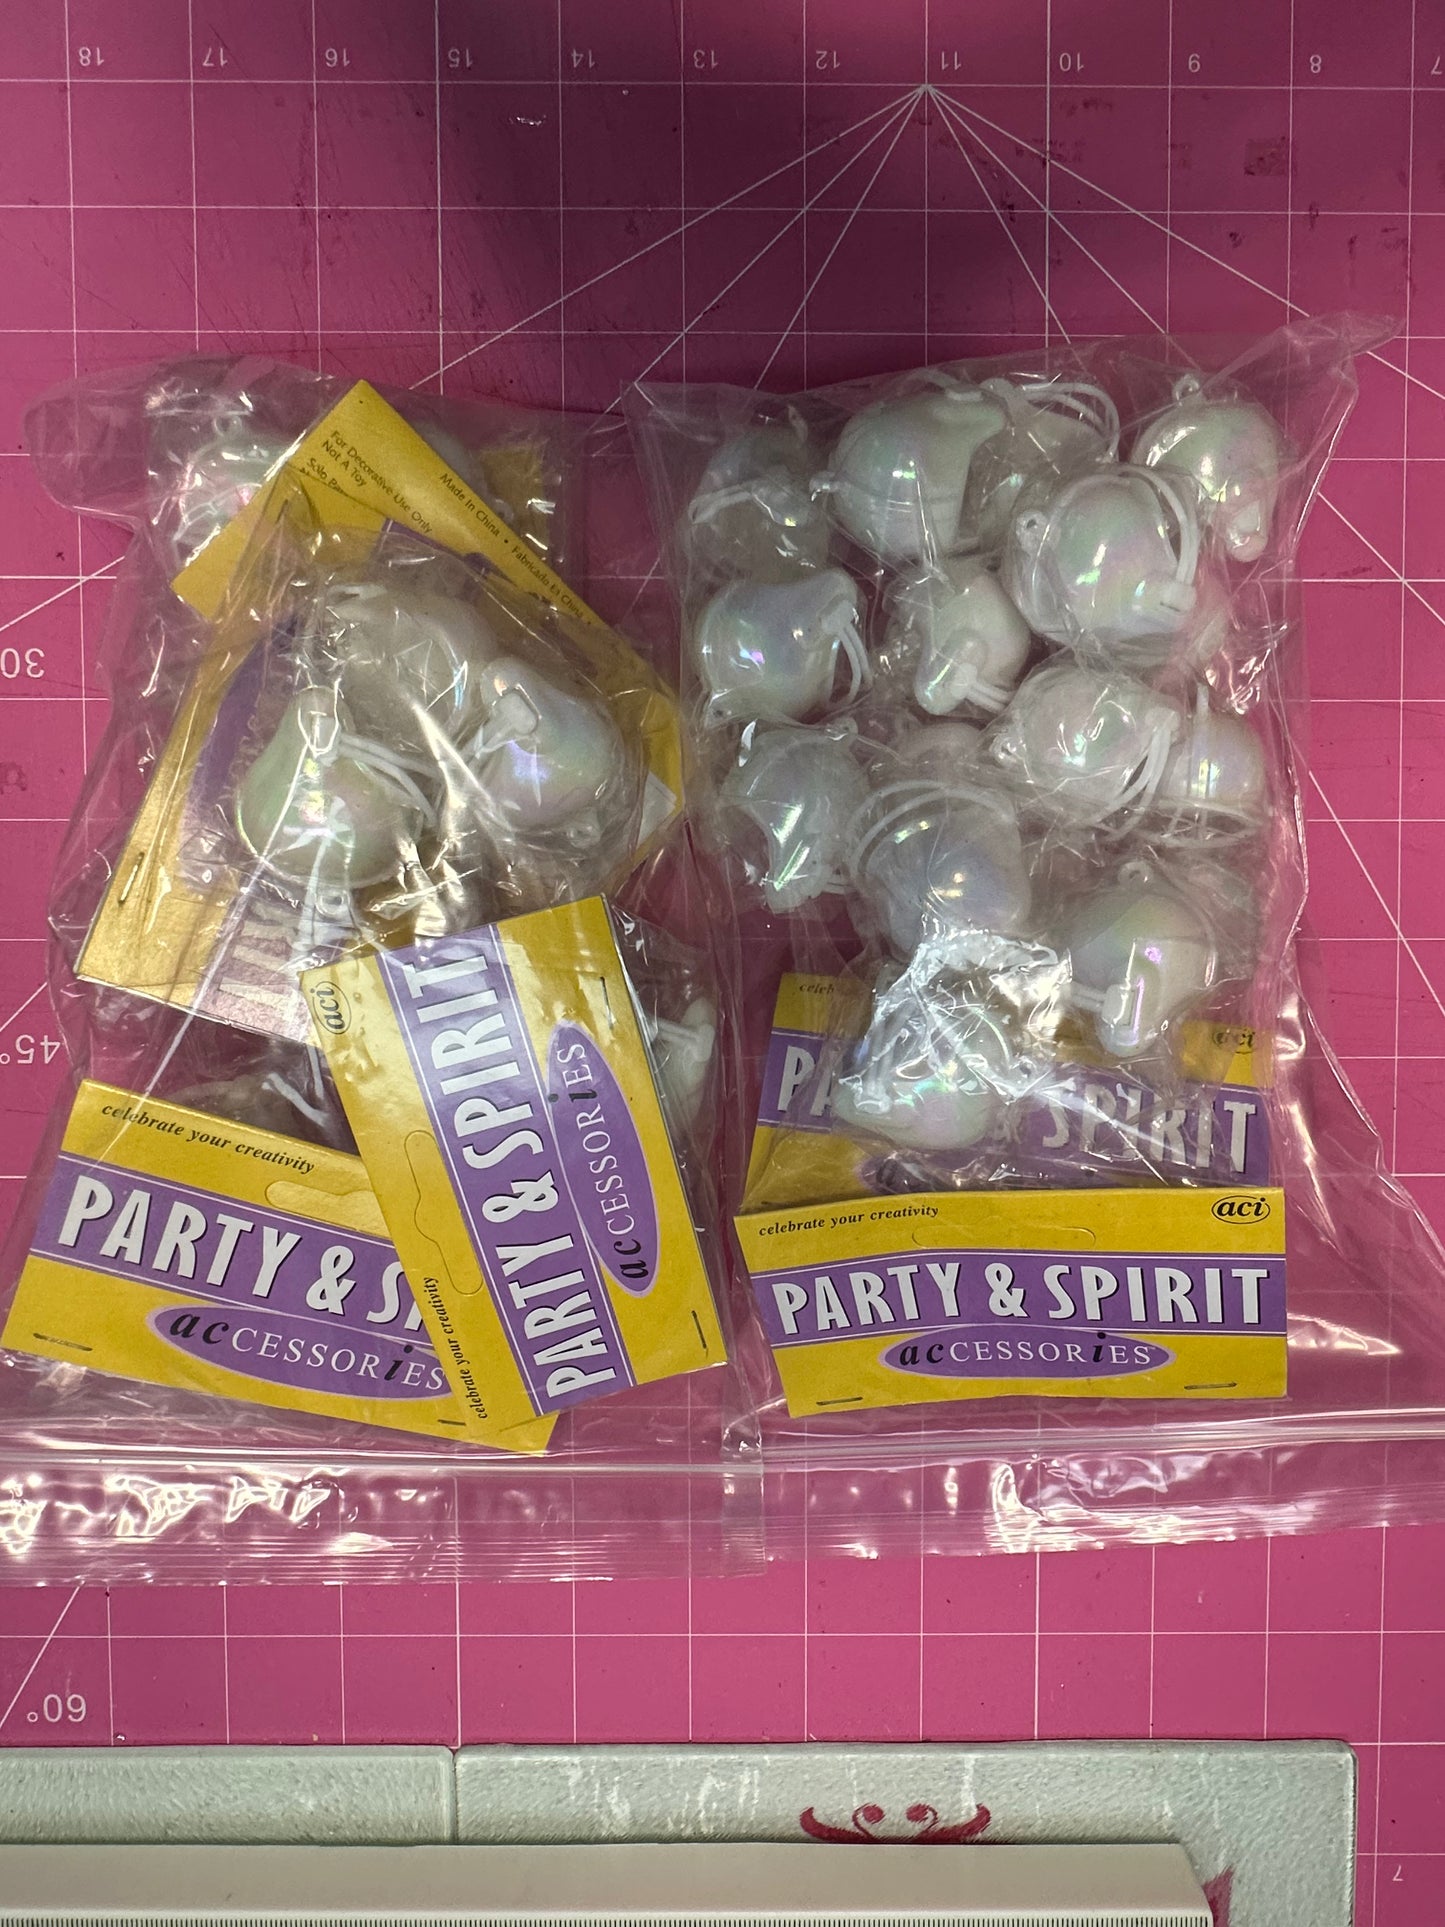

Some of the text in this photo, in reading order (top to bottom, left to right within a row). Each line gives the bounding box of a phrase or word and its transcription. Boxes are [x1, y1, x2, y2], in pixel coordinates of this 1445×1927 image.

[78, 46, 104, 66] 18
[202, 47, 227, 67] 17
[325, 47, 350, 67] 16
[447, 48, 473, 68] 15
[571, 49, 595, 69] 14
[693, 49, 718, 69] 13
[815, 50, 840, 70] 12
[941, 51, 962, 70] 11
[1059, 52, 1084, 72] 10
[1309, 54, 1322, 74] 8
[1430, 55, 1443, 75] 7
[306, 457, 328, 480] Solo
[322, 440, 368, 488] Not A Toy
[331, 430, 432, 535] For Decorative Use Only
[439, 472, 501, 538] Made In China
[511, 545, 550, 587] Fabricado
[101, 1103, 316, 1176] celebrate your creativity
[402, 954, 618, 1399] PARTY & SPIRIT
[1214, 1196, 1268, 1220] aci
[758, 1204, 940, 1237] celebrate your creativity
[57, 1174, 303, 1299] PARTY
[305, 1244, 357, 1316] &
[770, 1261, 1271, 1336] PARTY & SPIRIT
[423, 1276, 489, 1420] celebrate your creativity
